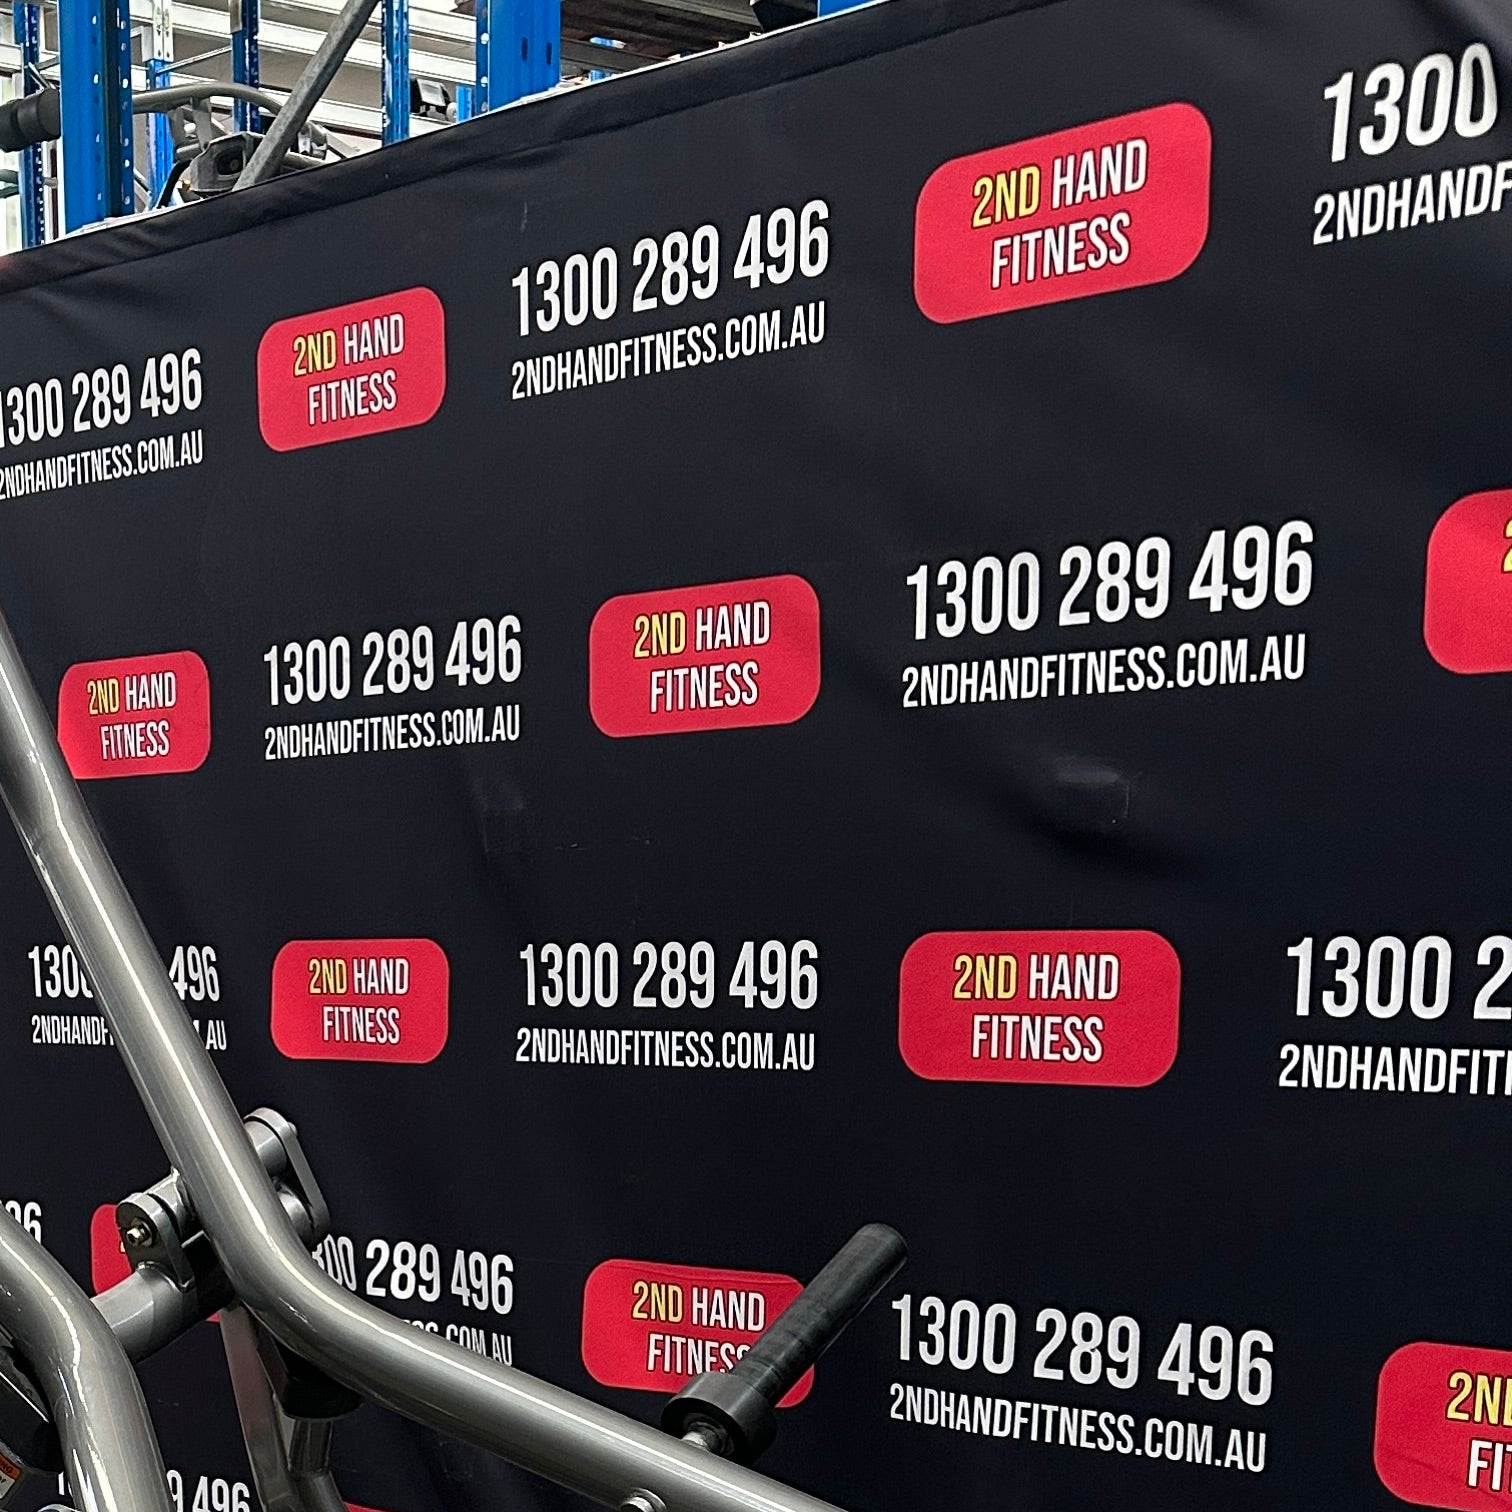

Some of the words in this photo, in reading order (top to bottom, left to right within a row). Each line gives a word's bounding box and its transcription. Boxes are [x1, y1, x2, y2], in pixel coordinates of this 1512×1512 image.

[1323, 42, 1498, 163] 1300
[972, 166, 1040, 228] 2ND
[1052, 138, 1147, 209] HAND
[511, 246, 618, 337] 1300
[632, 224, 719, 313] 289
[733, 199, 829, 289] 496
[992, 212, 1130, 289] FITNESS
[293, 330, 337, 376] 2ND
[343, 313, 404, 365] HAND
[511, 300, 825, 400] 2NDHANDFITNESS.COM.AU
[71, 363, 131, 433] 289
[139, 347, 202, 418] 496
[308, 369, 397, 425] FITNESS
[906, 551, 1040, 641] 1300
[1058, 536, 1171, 627] 289
[1188, 520, 1314, 613] 496
[263, 635, 351, 706] 1300
[362, 625, 435, 697] 289
[444, 614, 522, 687] 496
[634, 611, 686, 658] 2ND
[695, 601, 770, 651] HAND
[87, 678, 120, 715] 2ND
[125, 671, 177, 711] HAND
[650, 661, 759, 713] FITNESS
[902, 633, 1306, 708] 2NDHANDFITNESS.COM.AU
[100, 719, 170, 760] FITNESS
[264, 704, 520, 761] 2NDHANDFITNESS.COM.AU
[309, 958, 347, 994] 2ND
[353, 957, 409, 995] HAND
[519, 942, 619, 1008] 1300
[632, 940, 715, 1009] 289
[728, 939, 819, 1010] 496
[953, 954, 1017, 999] 2ND
[1028, 954, 1119, 1000] HAND
[1286, 935, 1452, 1020] 1300
[323, 1006, 400, 1044] FITNESS
[515, 1027, 815, 1071] 2NDHANDFITNESS.COM.AU
[972, 1014, 1103, 1062] FITNESS
[1278, 1043, 1512, 1096] 2NDHANDFIT
[365, 1238, 441, 1303] 289
[450, 1249, 514, 1315] 496
[632, 1281, 683, 1323] 2ND
[692, 1287, 765, 1332] HAND
[891, 1293, 1017, 1375] 1300
[1033, 1307, 1141, 1390] 289
[1157, 1322, 1274, 1406] 496
[889, 1382, 1267, 1473] 2NDHANDFITNESS.COM.AU
